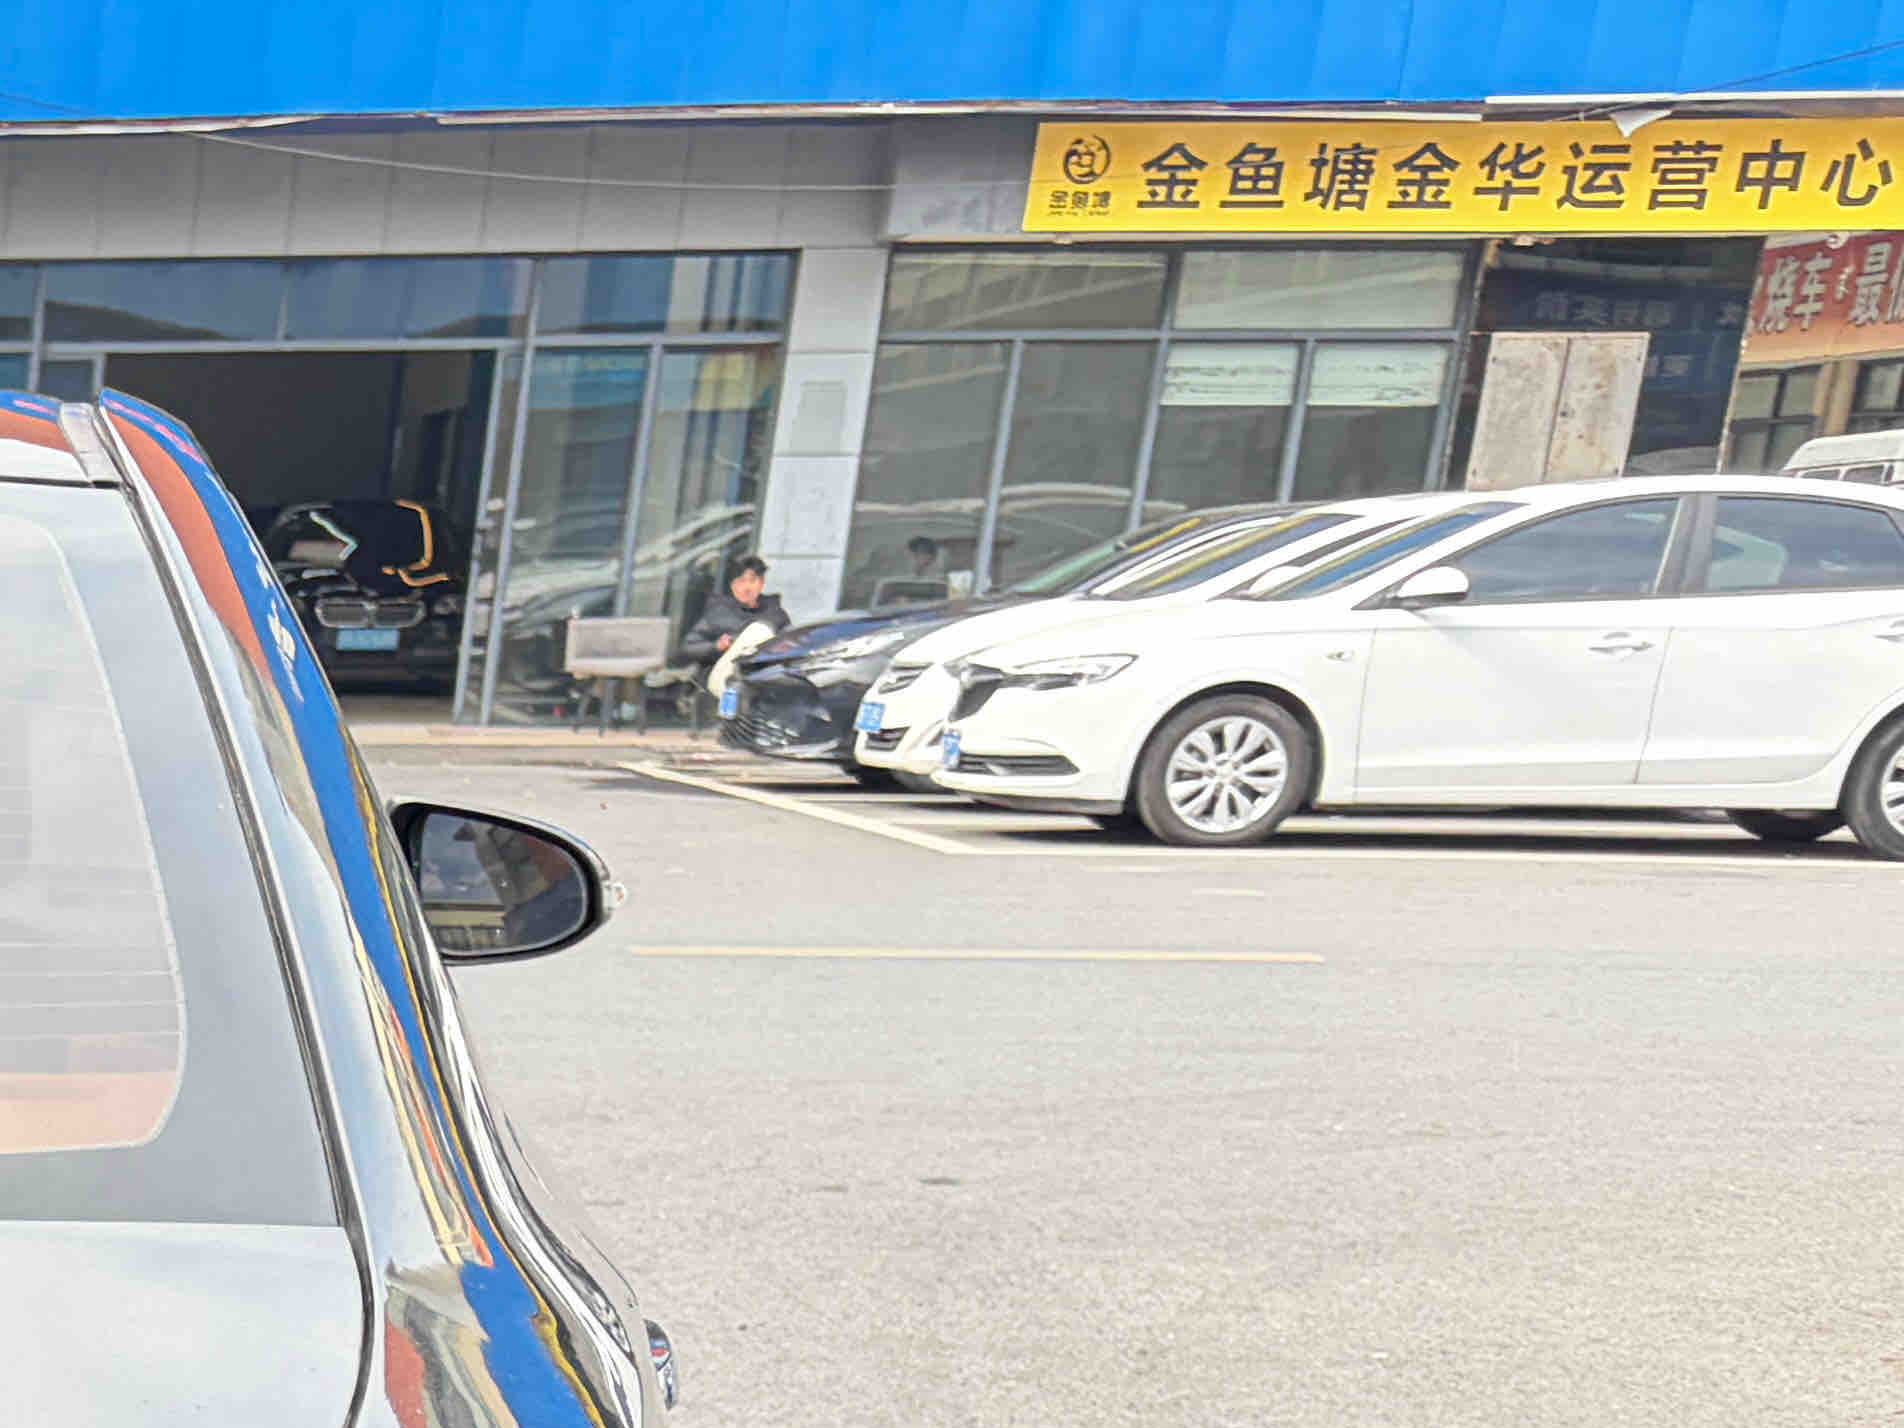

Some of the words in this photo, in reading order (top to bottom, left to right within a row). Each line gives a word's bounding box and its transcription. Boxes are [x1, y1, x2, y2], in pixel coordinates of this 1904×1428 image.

[1136, 137, 1894, 213] 金鱼塘金华运营中心
